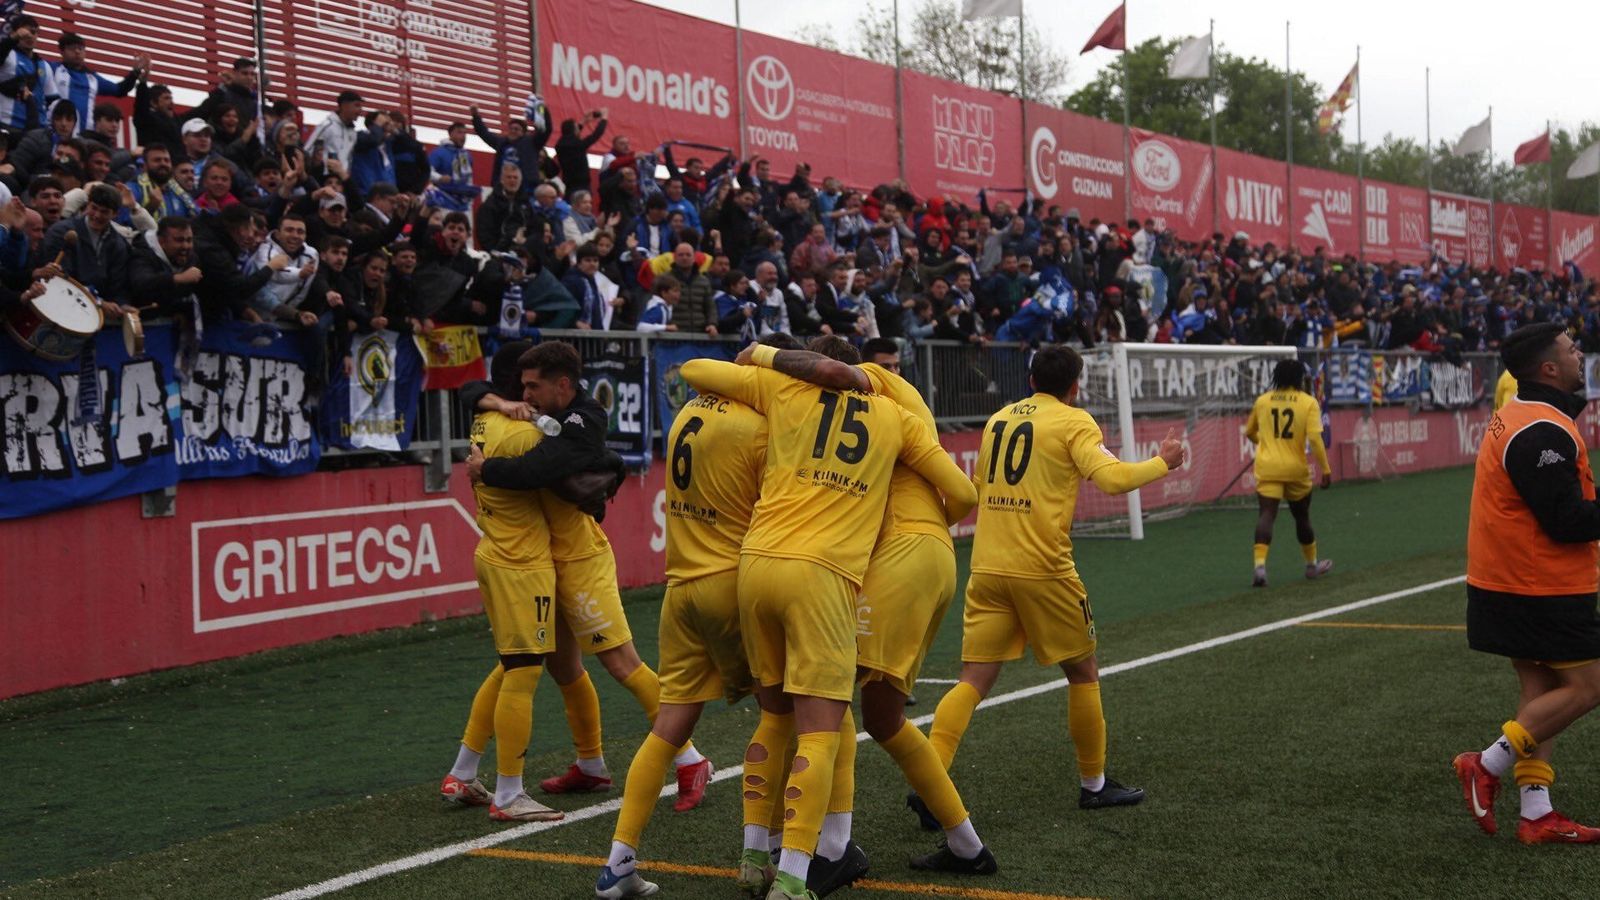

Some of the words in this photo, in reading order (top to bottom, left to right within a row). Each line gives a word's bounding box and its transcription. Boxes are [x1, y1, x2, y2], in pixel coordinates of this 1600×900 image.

[551, 42, 731, 119] McDonald's
[748, 126, 799, 153] TOYOTA
[1058, 150, 1125, 178] CONSTRUCCIONS
[1143, 147, 1171, 182] Ford
[180, 351, 312, 444] SUR
[1153, 358, 1196, 398] TAR
[1204, 359, 1239, 396] TAR
[618, 382, 641, 432] 22
[812, 391, 869, 464] 15
[1010, 404, 1037, 415] NICO
[1271, 408, 1294, 439] 12
[672, 416, 704, 491] 6
[987, 420, 1034, 486] 10
[213, 522, 442, 604] GRITECSA
[534, 595, 551, 623] 17
